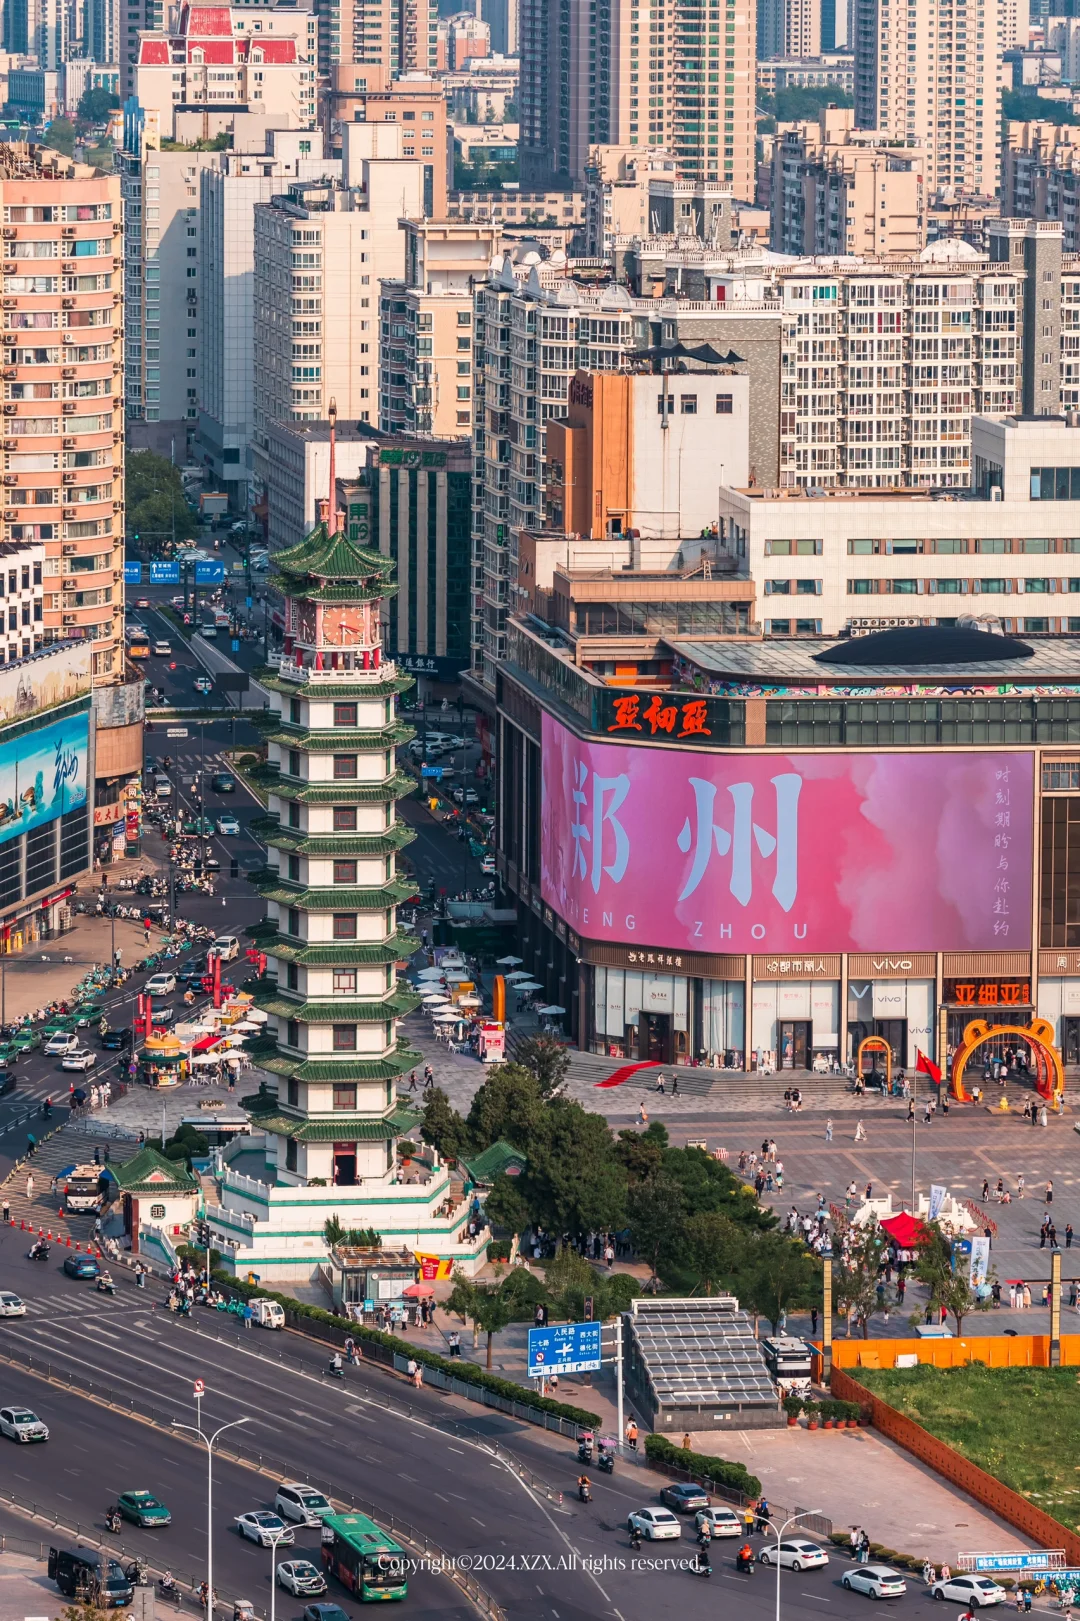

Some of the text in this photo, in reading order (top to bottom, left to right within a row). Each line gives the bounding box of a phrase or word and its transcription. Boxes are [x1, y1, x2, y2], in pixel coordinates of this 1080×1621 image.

[571, 757, 803, 912] 郑州
[993, 766, 1012, 936] 时刻期盼与你赴约
[693, 920, 808, 940] ZHOU
[780, 960, 826, 973] 都市丽人
[873, 958, 912, 970] vivo
[955, 983, 1020, 1006] 亚细亚
[554, 1327, 576, 1337] 人民路
[530, 1339, 550, 1348] 二七路
[579, 1343, 599, 1352] 德化街
